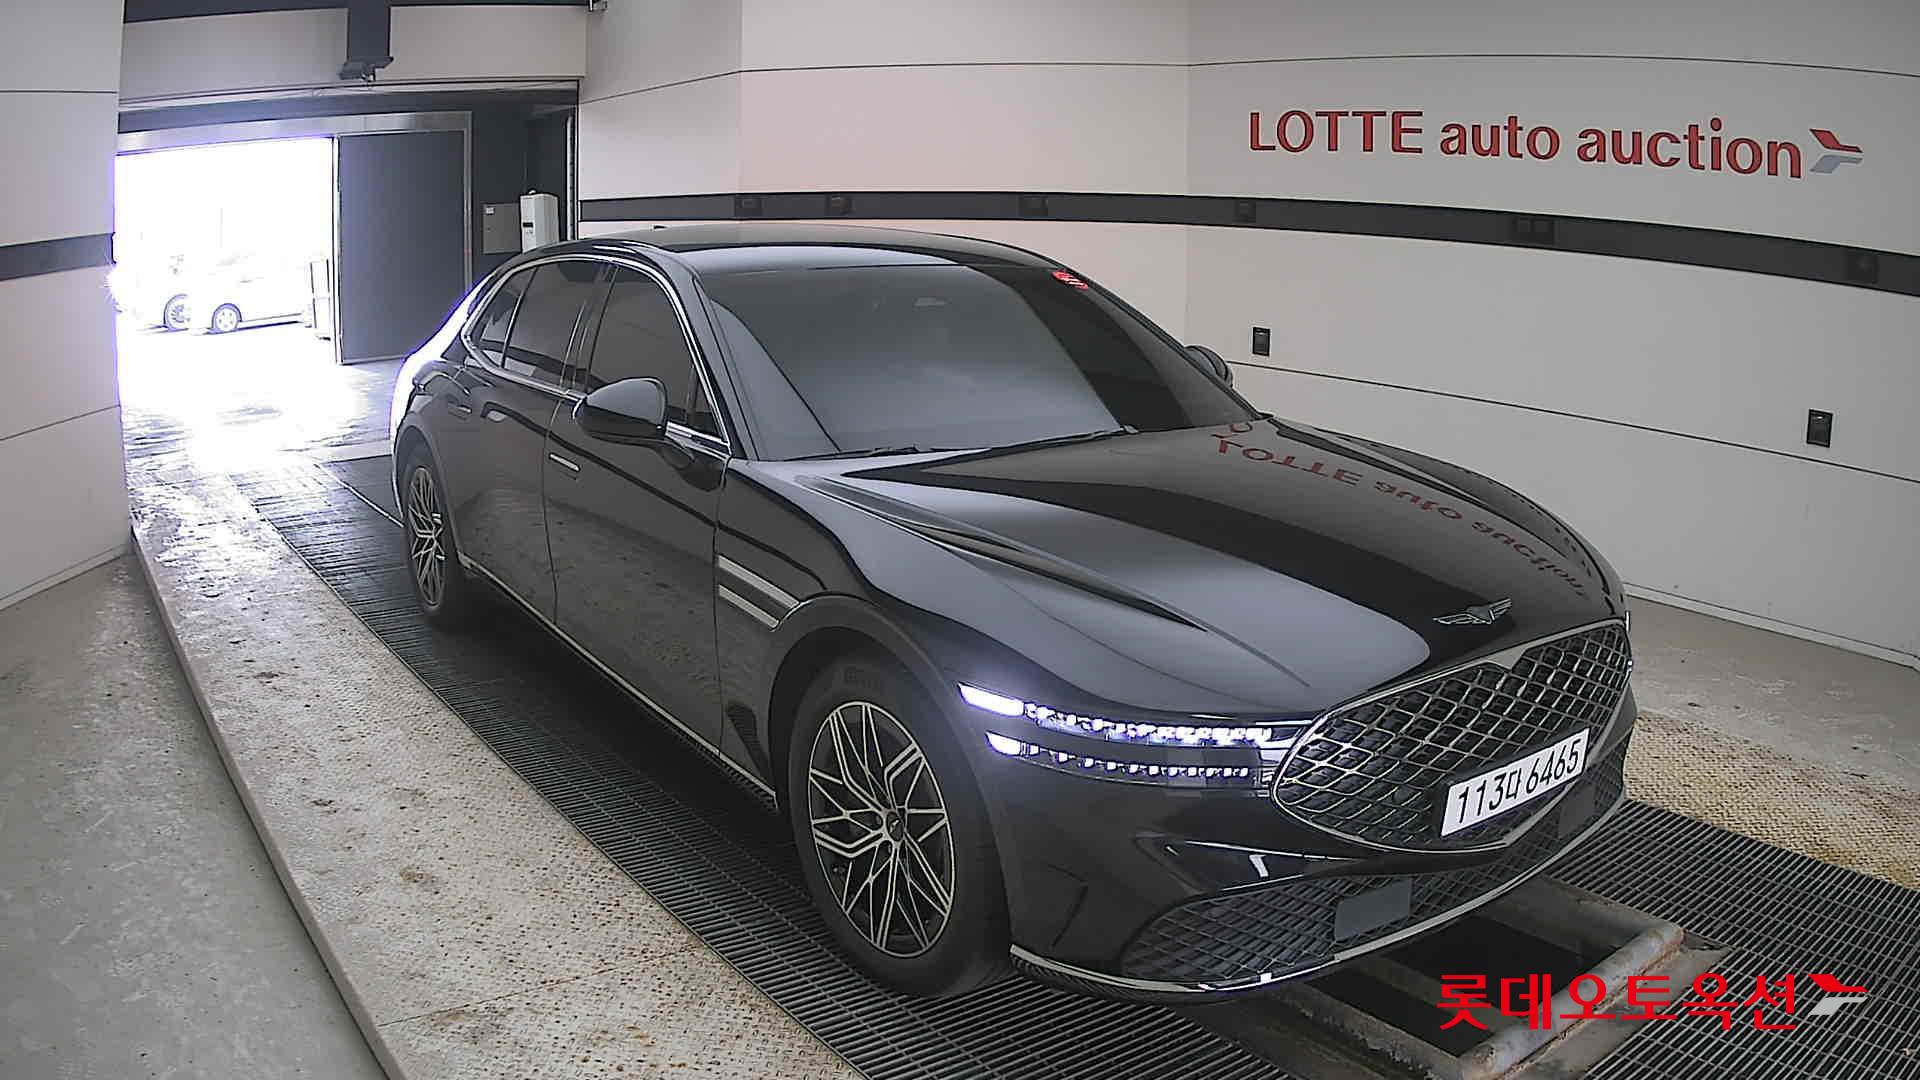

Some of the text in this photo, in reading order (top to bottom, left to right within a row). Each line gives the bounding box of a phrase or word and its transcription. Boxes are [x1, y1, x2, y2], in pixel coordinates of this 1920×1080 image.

[1248, 110, 1803, 179] LOTTE auto auction
[1526, 738, 1582, 794] 6465
